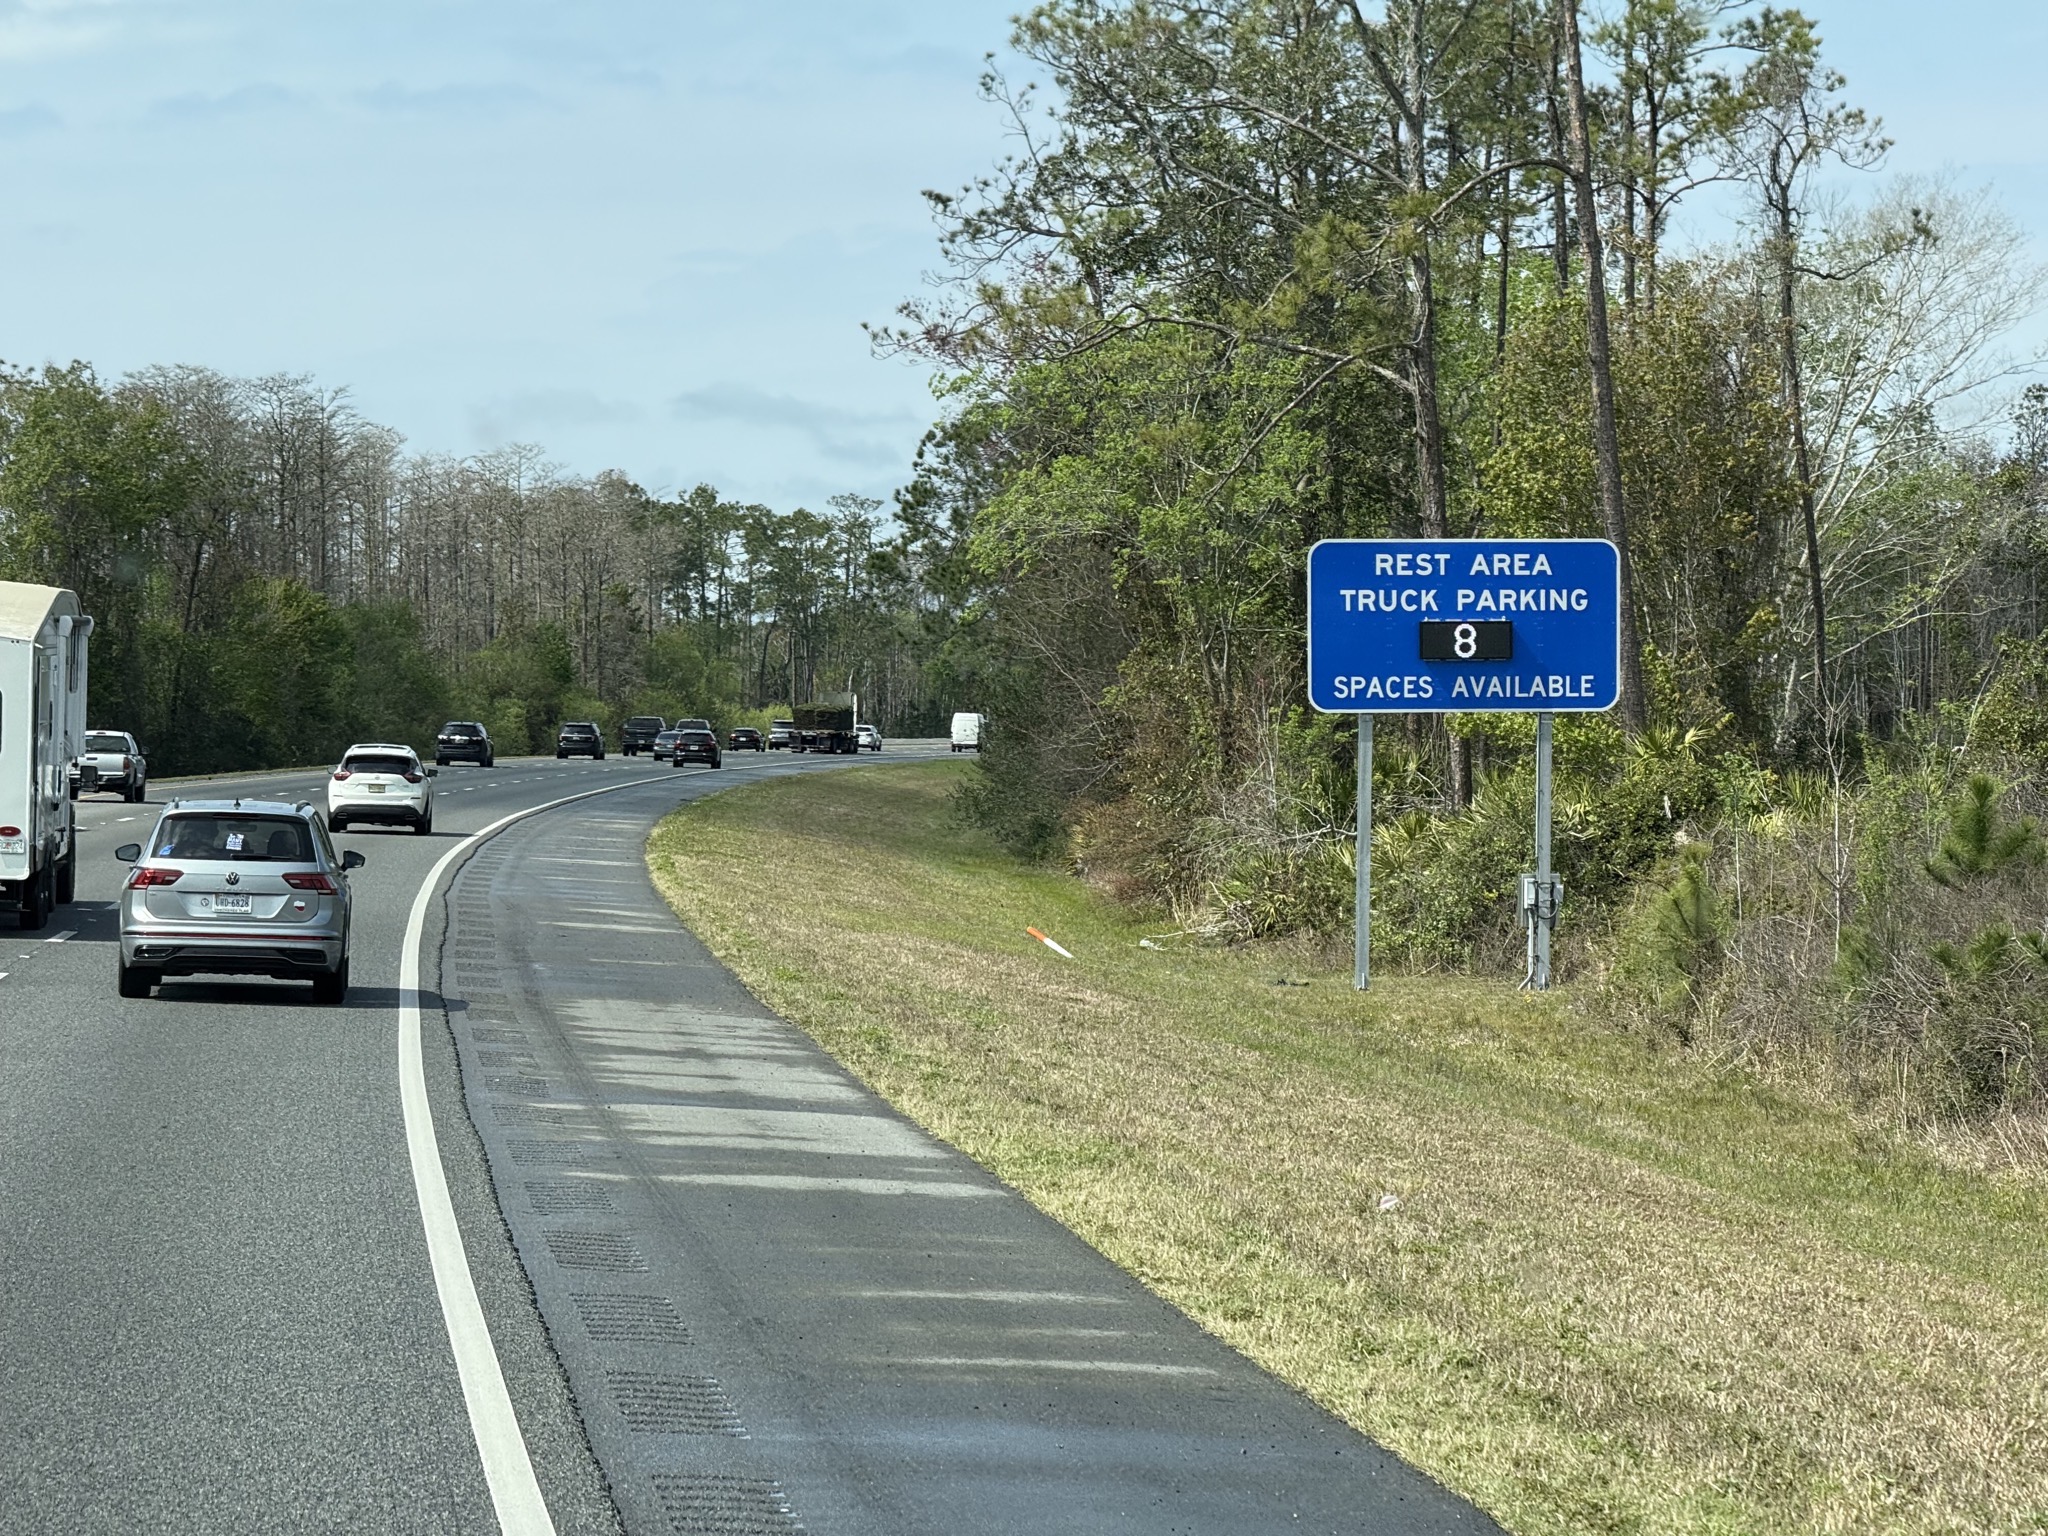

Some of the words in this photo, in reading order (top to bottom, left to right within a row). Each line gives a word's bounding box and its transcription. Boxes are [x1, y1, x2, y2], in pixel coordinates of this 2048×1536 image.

[1375, 553, 1451, 576] REST
[1469, 553, 1553, 576] AREA
[1339, 589, 1439, 612] TRUCK
[1457, 588, 1588, 611] PARKING
[1453, 623, 1477, 659] 8
[1333, 675, 1433, 699] SPACES
[1451, 675, 1595, 698] AVAILABLE
